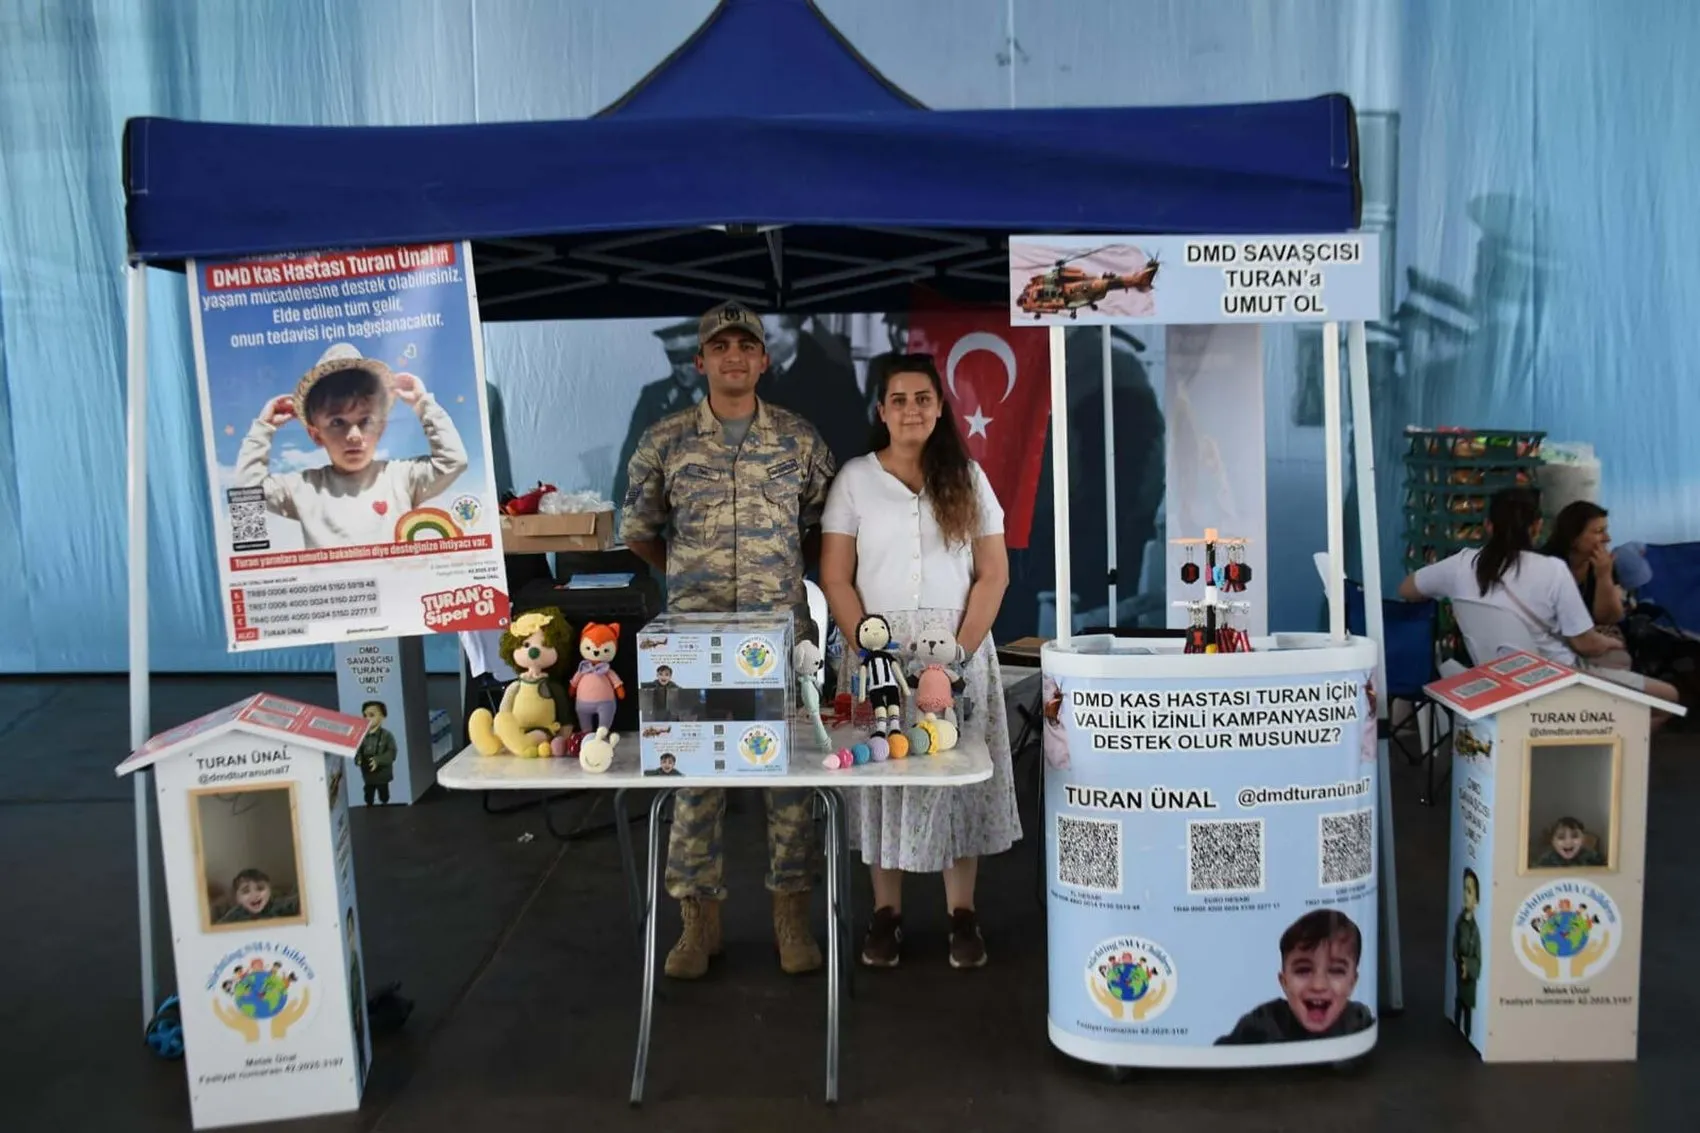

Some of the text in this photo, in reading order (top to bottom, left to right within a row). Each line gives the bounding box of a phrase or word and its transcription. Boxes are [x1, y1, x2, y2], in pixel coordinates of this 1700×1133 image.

[1187, 243, 1359, 266] DMD SAVAŞCISI
[213, 266, 251, 288] DMD
[252, 265, 281, 284] Kas
[283, 259, 346, 281] Hastası
[347, 253, 396, 275] Turan
[1226, 269, 1321, 287] TURAN'a
[202, 267, 463, 311] yaşam mücadelesine destek olabilirsiniz.
[272, 306, 300, 324] Elde
[303, 302, 343, 321] edilen
[344, 300, 370, 317] tüm
[1224, 295, 1324, 313] UMUT OL
[230, 312, 445, 348] onun tedavisi için bağışlanacaktır.
[472, 538, 488, 547] var.
[289, 585, 308, 594] 4000
[423, 586, 495, 610] TURAN'a
[425, 606, 470, 626] Siper
[360, 646, 379, 654] DMD
[358, 676, 384, 684] UMUT
[366, 686, 378, 694] OL
[1073, 682, 1358, 707] DMD KAS HASTASI TURAN İÇİN
[1074, 705, 1357, 729] VALİLİK İZİNLİ KAMPANYASINA
[1530, 709, 1616, 723] TURAN ÜNAL
[1094, 727, 1341, 750] DESTEK OLUR MUSUNUZ?
[196, 754, 247, 769] TURAN
[1065, 777, 1370, 809] TURAN ÜNAL @dmdturanünal7
